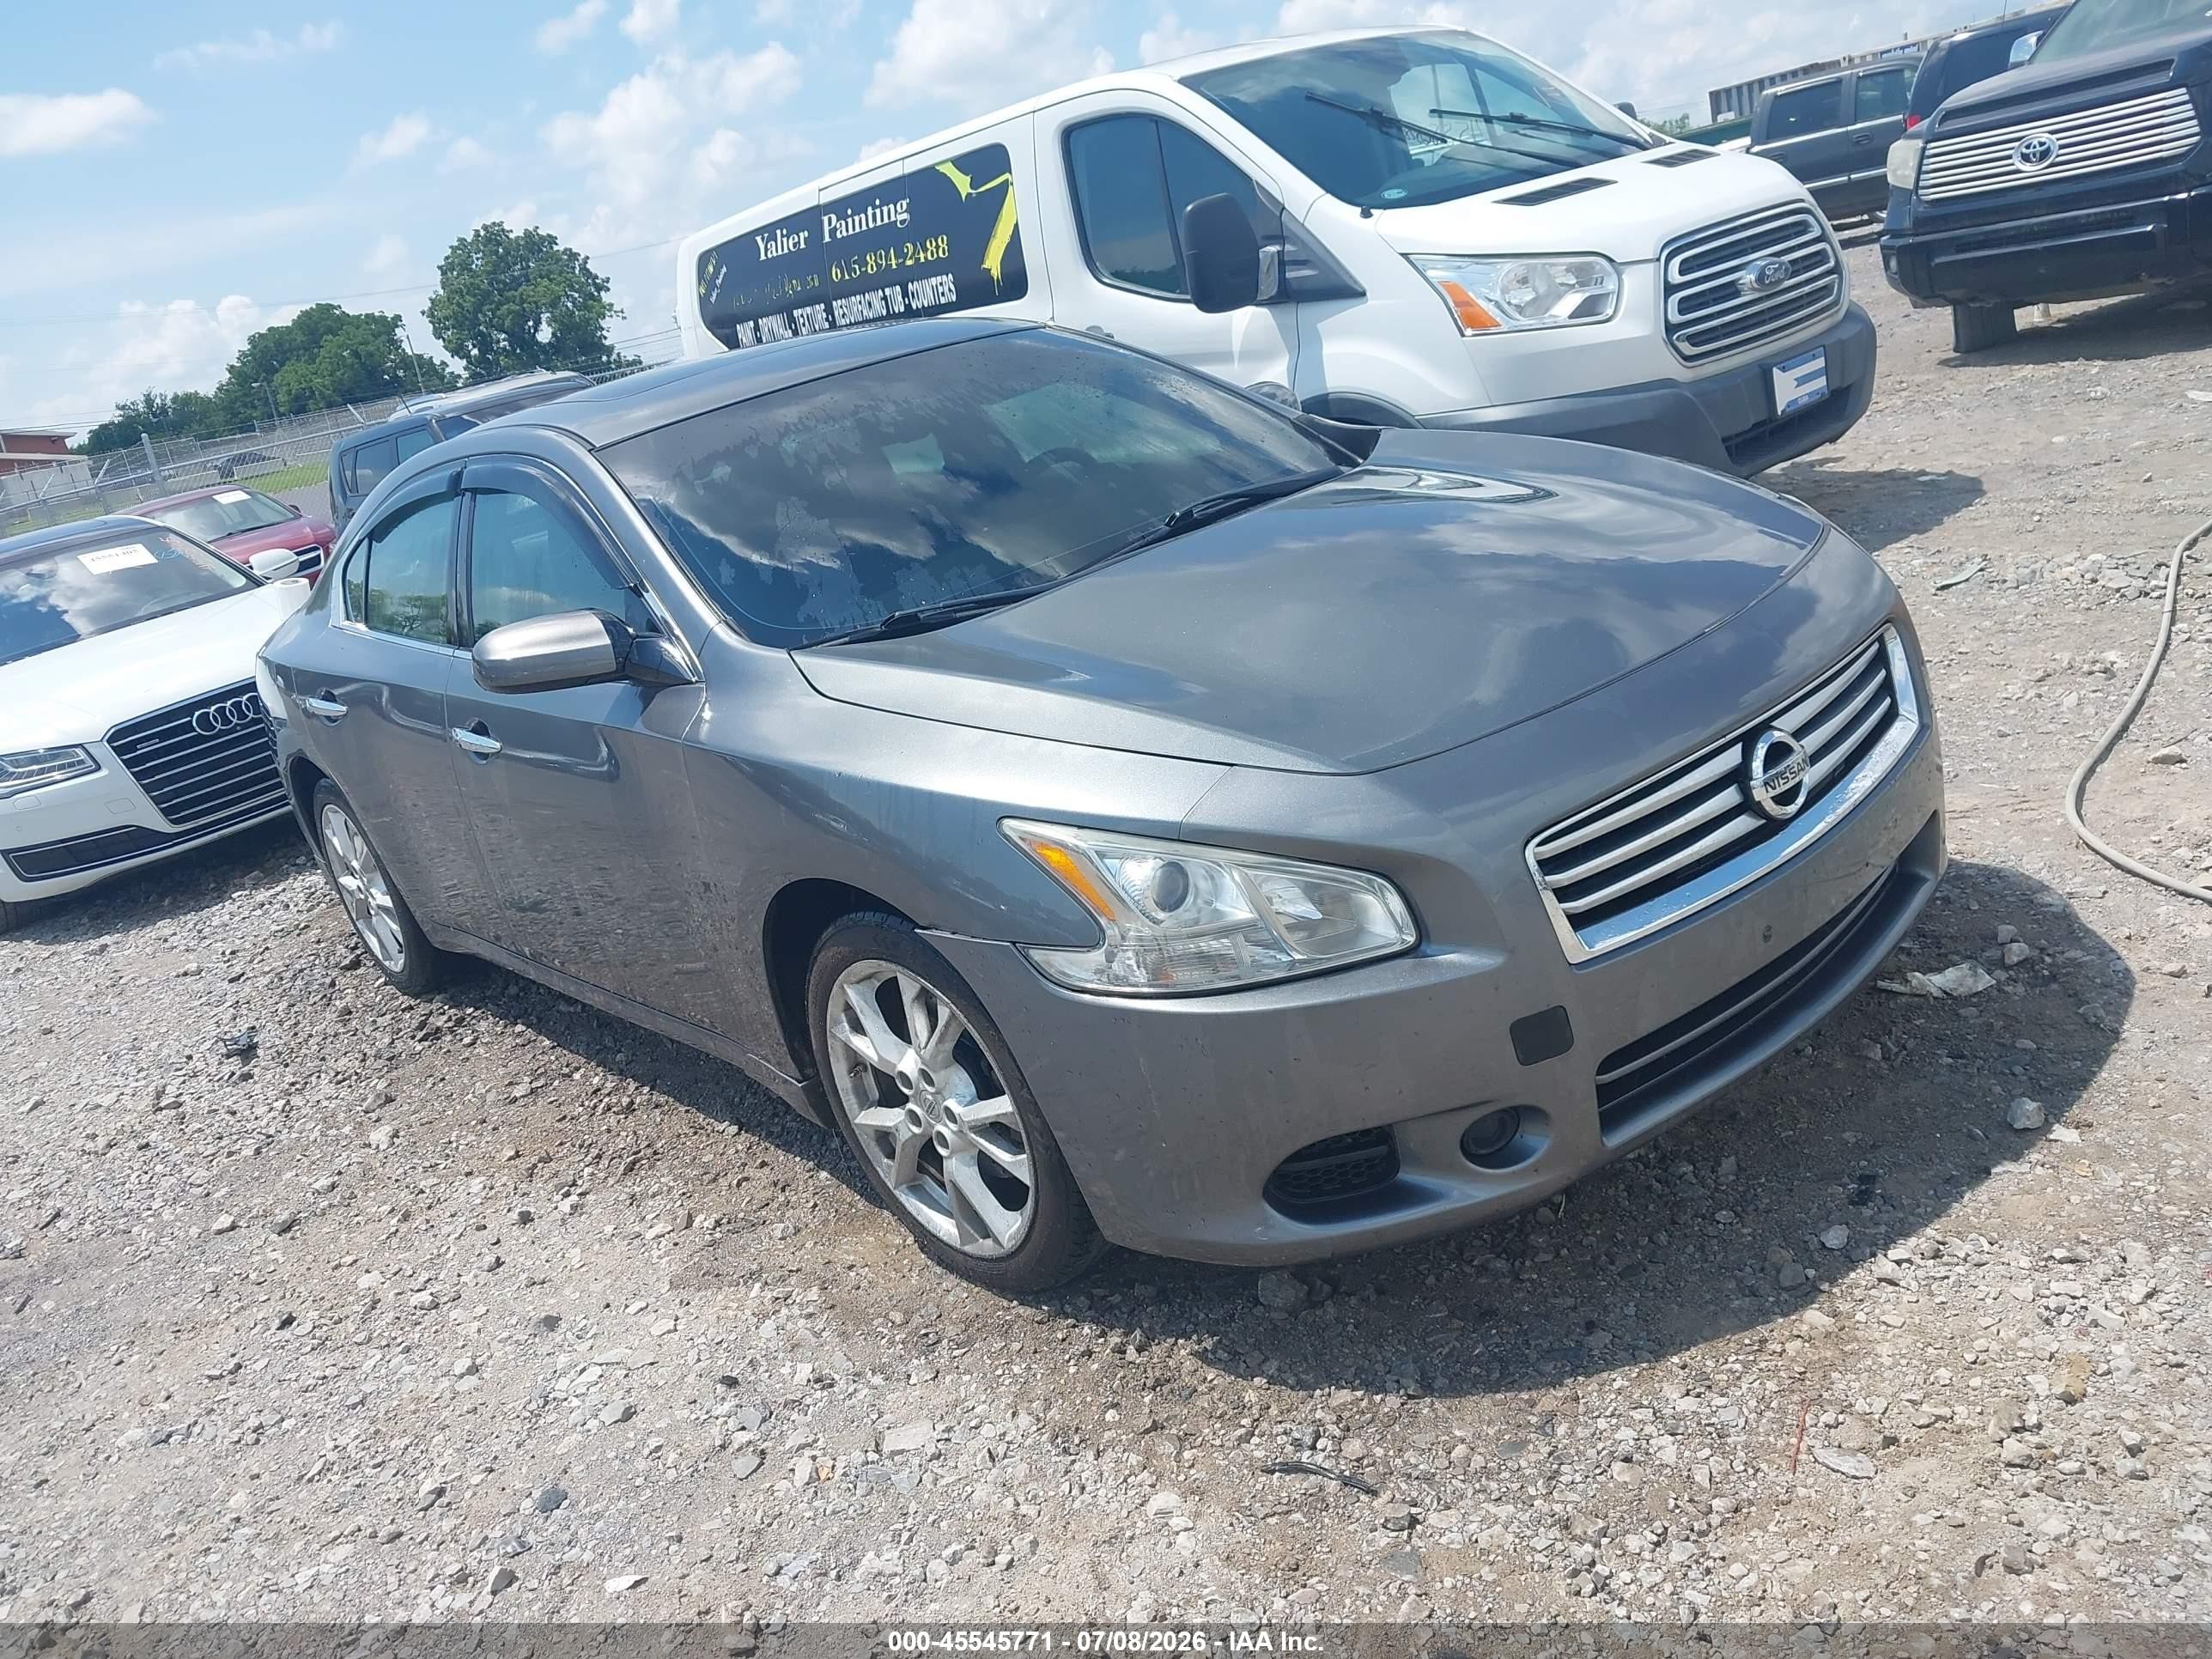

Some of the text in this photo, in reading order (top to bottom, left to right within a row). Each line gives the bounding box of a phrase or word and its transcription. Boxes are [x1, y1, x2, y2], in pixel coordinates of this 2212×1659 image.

[755, 198, 910, 261] Yalier Painting
[831, 234, 949, 283] 615-894-2488
[736, 320, 757, 348] PAINT
[758, 312, 793, 343] DRYWALL
[793, 303, 830, 337] TEXTURE
[832, 289, 887, 327] RESURFACING
[884, 285, 905, 314] TUB
[908, 273, 957, 310] COUNTERS
[1763, 757, 1810, 793] NISSAN
